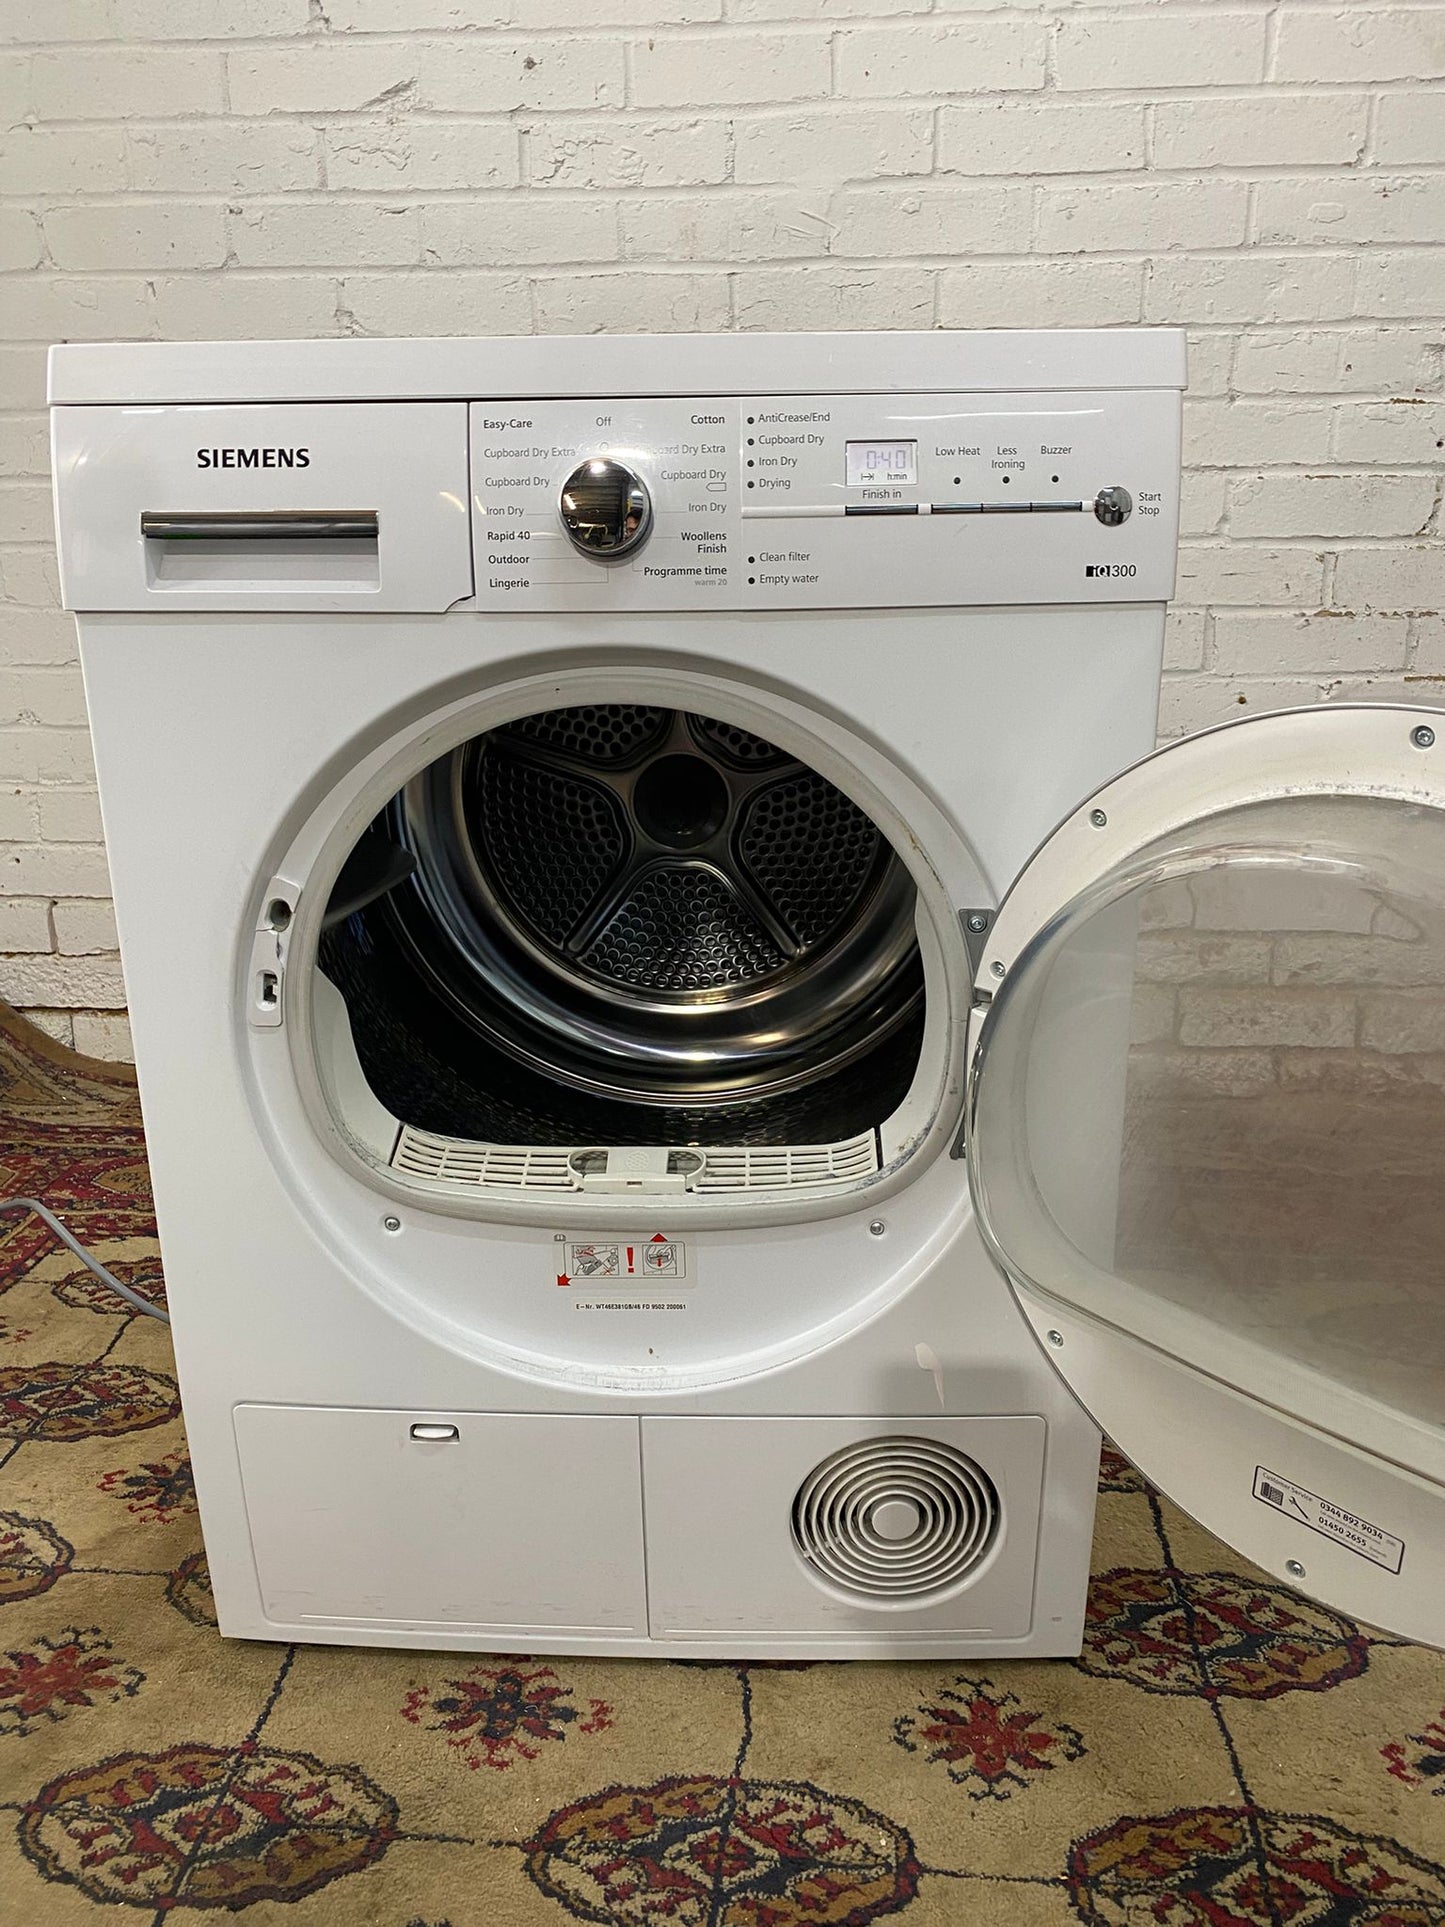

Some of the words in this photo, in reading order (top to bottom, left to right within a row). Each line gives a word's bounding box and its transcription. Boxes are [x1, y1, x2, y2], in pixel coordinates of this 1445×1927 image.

[595, 416, 612, 426] Off
[690, 414, 725, 424] Cotton
[758, 412, 831, 423] AntiCrease/End
[483, 419, 533, 431] Easy-Care
[758, 434, 805, 446] Cupboard
[807, 433, 825, 446] Dry
[484, 447, 530, 459] Cupboard
[532, 447, 549, 459] Dry
[551, 447, 576, 457] Extra
[682, 444, 699, 456] Dry
[701, 443, 726, 454] Extra
[935, 447, 955, 456] Low
[958, 446, 981, 456] Heat
[996, 446, 1017, 455] Less
[1040, 445, 1072, 455] Buzzer
[197, 448, 310, 468] SIEMENS
[759, 456, 778, 466] Iron
[780, 456, 797, 468] Dry
[866, 450, 906, 469] 0:40
[991, 459, 1025, 471] Ironing
[660, 469, 707, 481] Cupboard
[709, 469, 727, 481] Dry
[485, 476, 531, 488] Cupboard
[533, 476, 550, 488] Dry
[759, 477, 791, 489] Drying
[862, 489, 890, 499] Finish
[892, 489, 902, 498] in
[1138, 492, 1161, 501] Start
[486, 506, 505, 516] Iron
[507, 506, 524, 517] Dry
[688, 502, 707, 512] Iron
[710, 502, 727, 514] Dry
[1138, 505, 1160, 516] Stop
[487, 531, 515, 542] Rapid
[517, 531, 531, 540] 40
[681, 531, 727, 541] Woollens
[697, 543, 727, 553] Finish
[488, 555, 530, 564] Outdoor
[759, 552, 786, 562] Clean
[788, 551, 811, 561] filter
[644, 566, 702, 578] Programme
[704, 565, 727, 575] time
[489, 578, 530, 590] Lingerie
[718, 578, 728, 586] 20
[759, 574, 790, 585] Empty
[792, 574, 819, 583] water
[1320, 1502, 1341, 1518] 0344
[1342, 1512, 1359, 1527] 892
[1361, 1523, 1383, 1540] 9034
[1318, 1516, 1344, 1534] 01450
[1346, 1530, 1367, 1547] 2655
